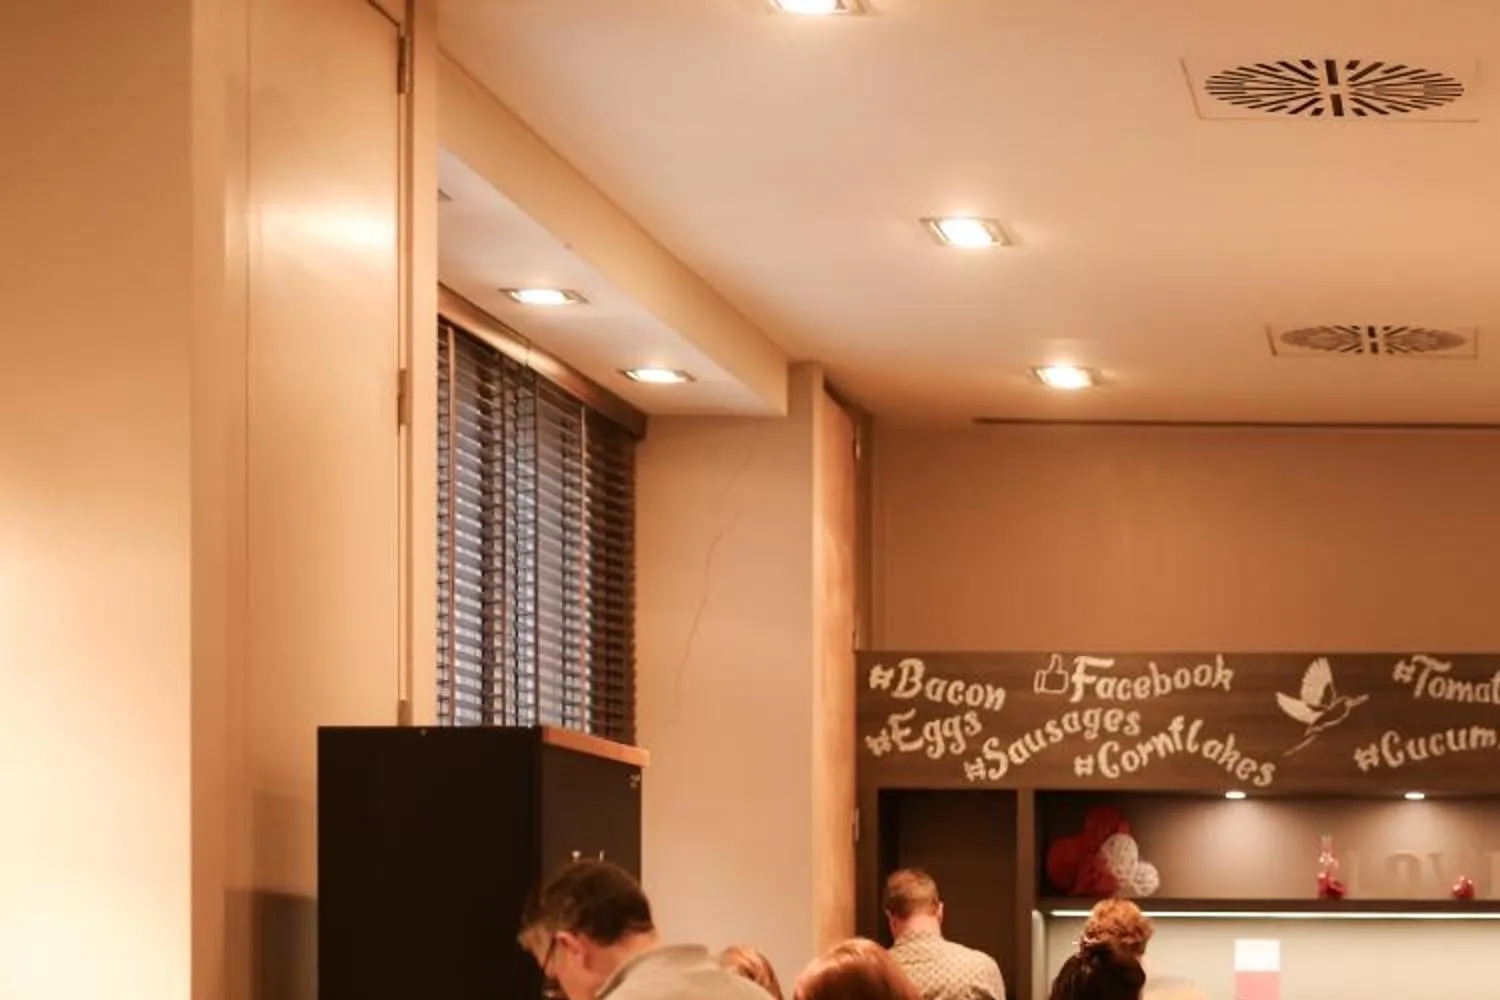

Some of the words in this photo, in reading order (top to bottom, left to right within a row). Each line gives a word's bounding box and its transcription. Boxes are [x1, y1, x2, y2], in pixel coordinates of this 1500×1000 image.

[868, 658, 1006, 711] #Bacon
[1070, 654, 1235, 703] Facebook
[865, 708, 983, 759] #Eggs
[963, 706, 1142, 782] #Sausages
[1074, 715, 1277, 787] #Cornflakes
